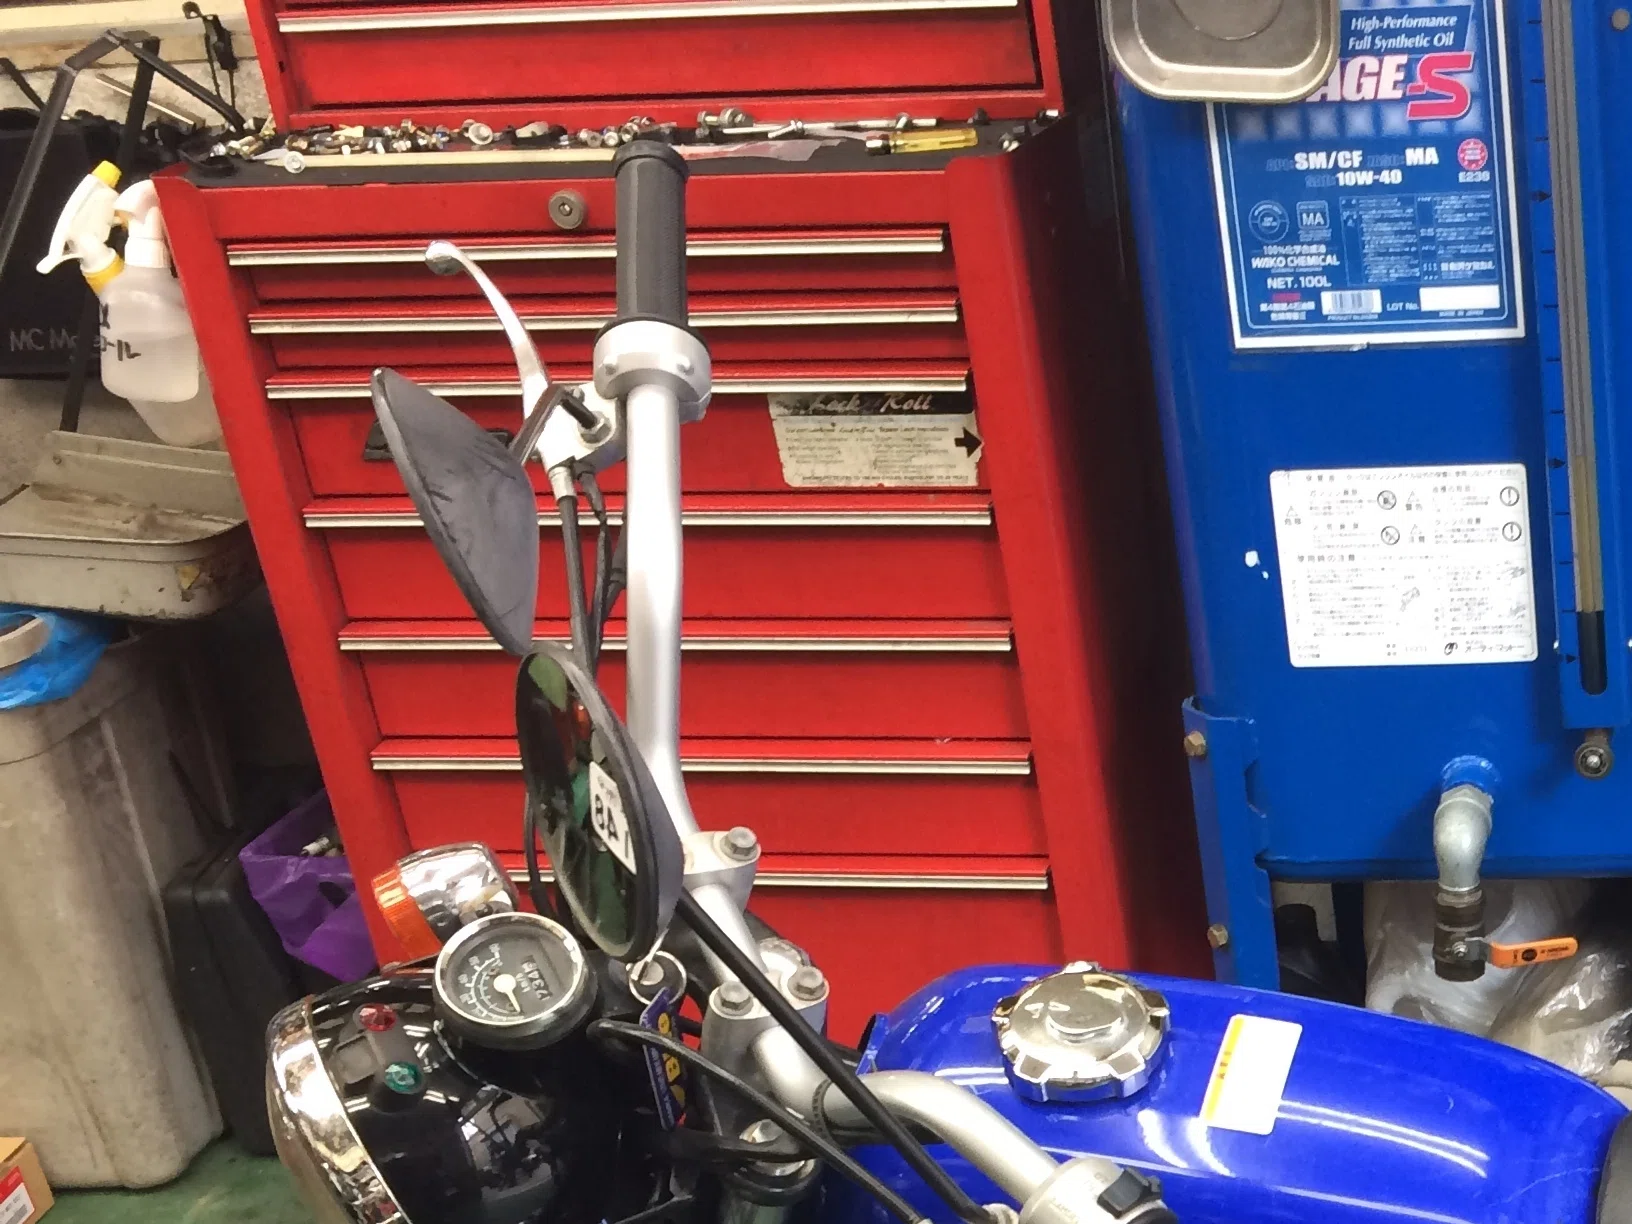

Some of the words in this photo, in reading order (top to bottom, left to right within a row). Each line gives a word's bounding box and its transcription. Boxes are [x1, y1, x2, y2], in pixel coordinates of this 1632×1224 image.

[1351, 15, 1457, 33] High-Performance
[1348, 35, 1371, 50] Full
[1374, 33, 1431, 51] Synthetic
[1433, 31, 1454, 47] Oil
[1294, 150, 1363, 171] SM/CF
[1405, 147, 1439, 166] MA
[1336, 169, 1402, 186] 10W-40
[1302, 212, 1325, 226] MA
[1287, 253, 1340, 267] CHEMICAL
[1299, 275, 1332, 289] 100L
[1386, 302, 1404, 311] LOT
